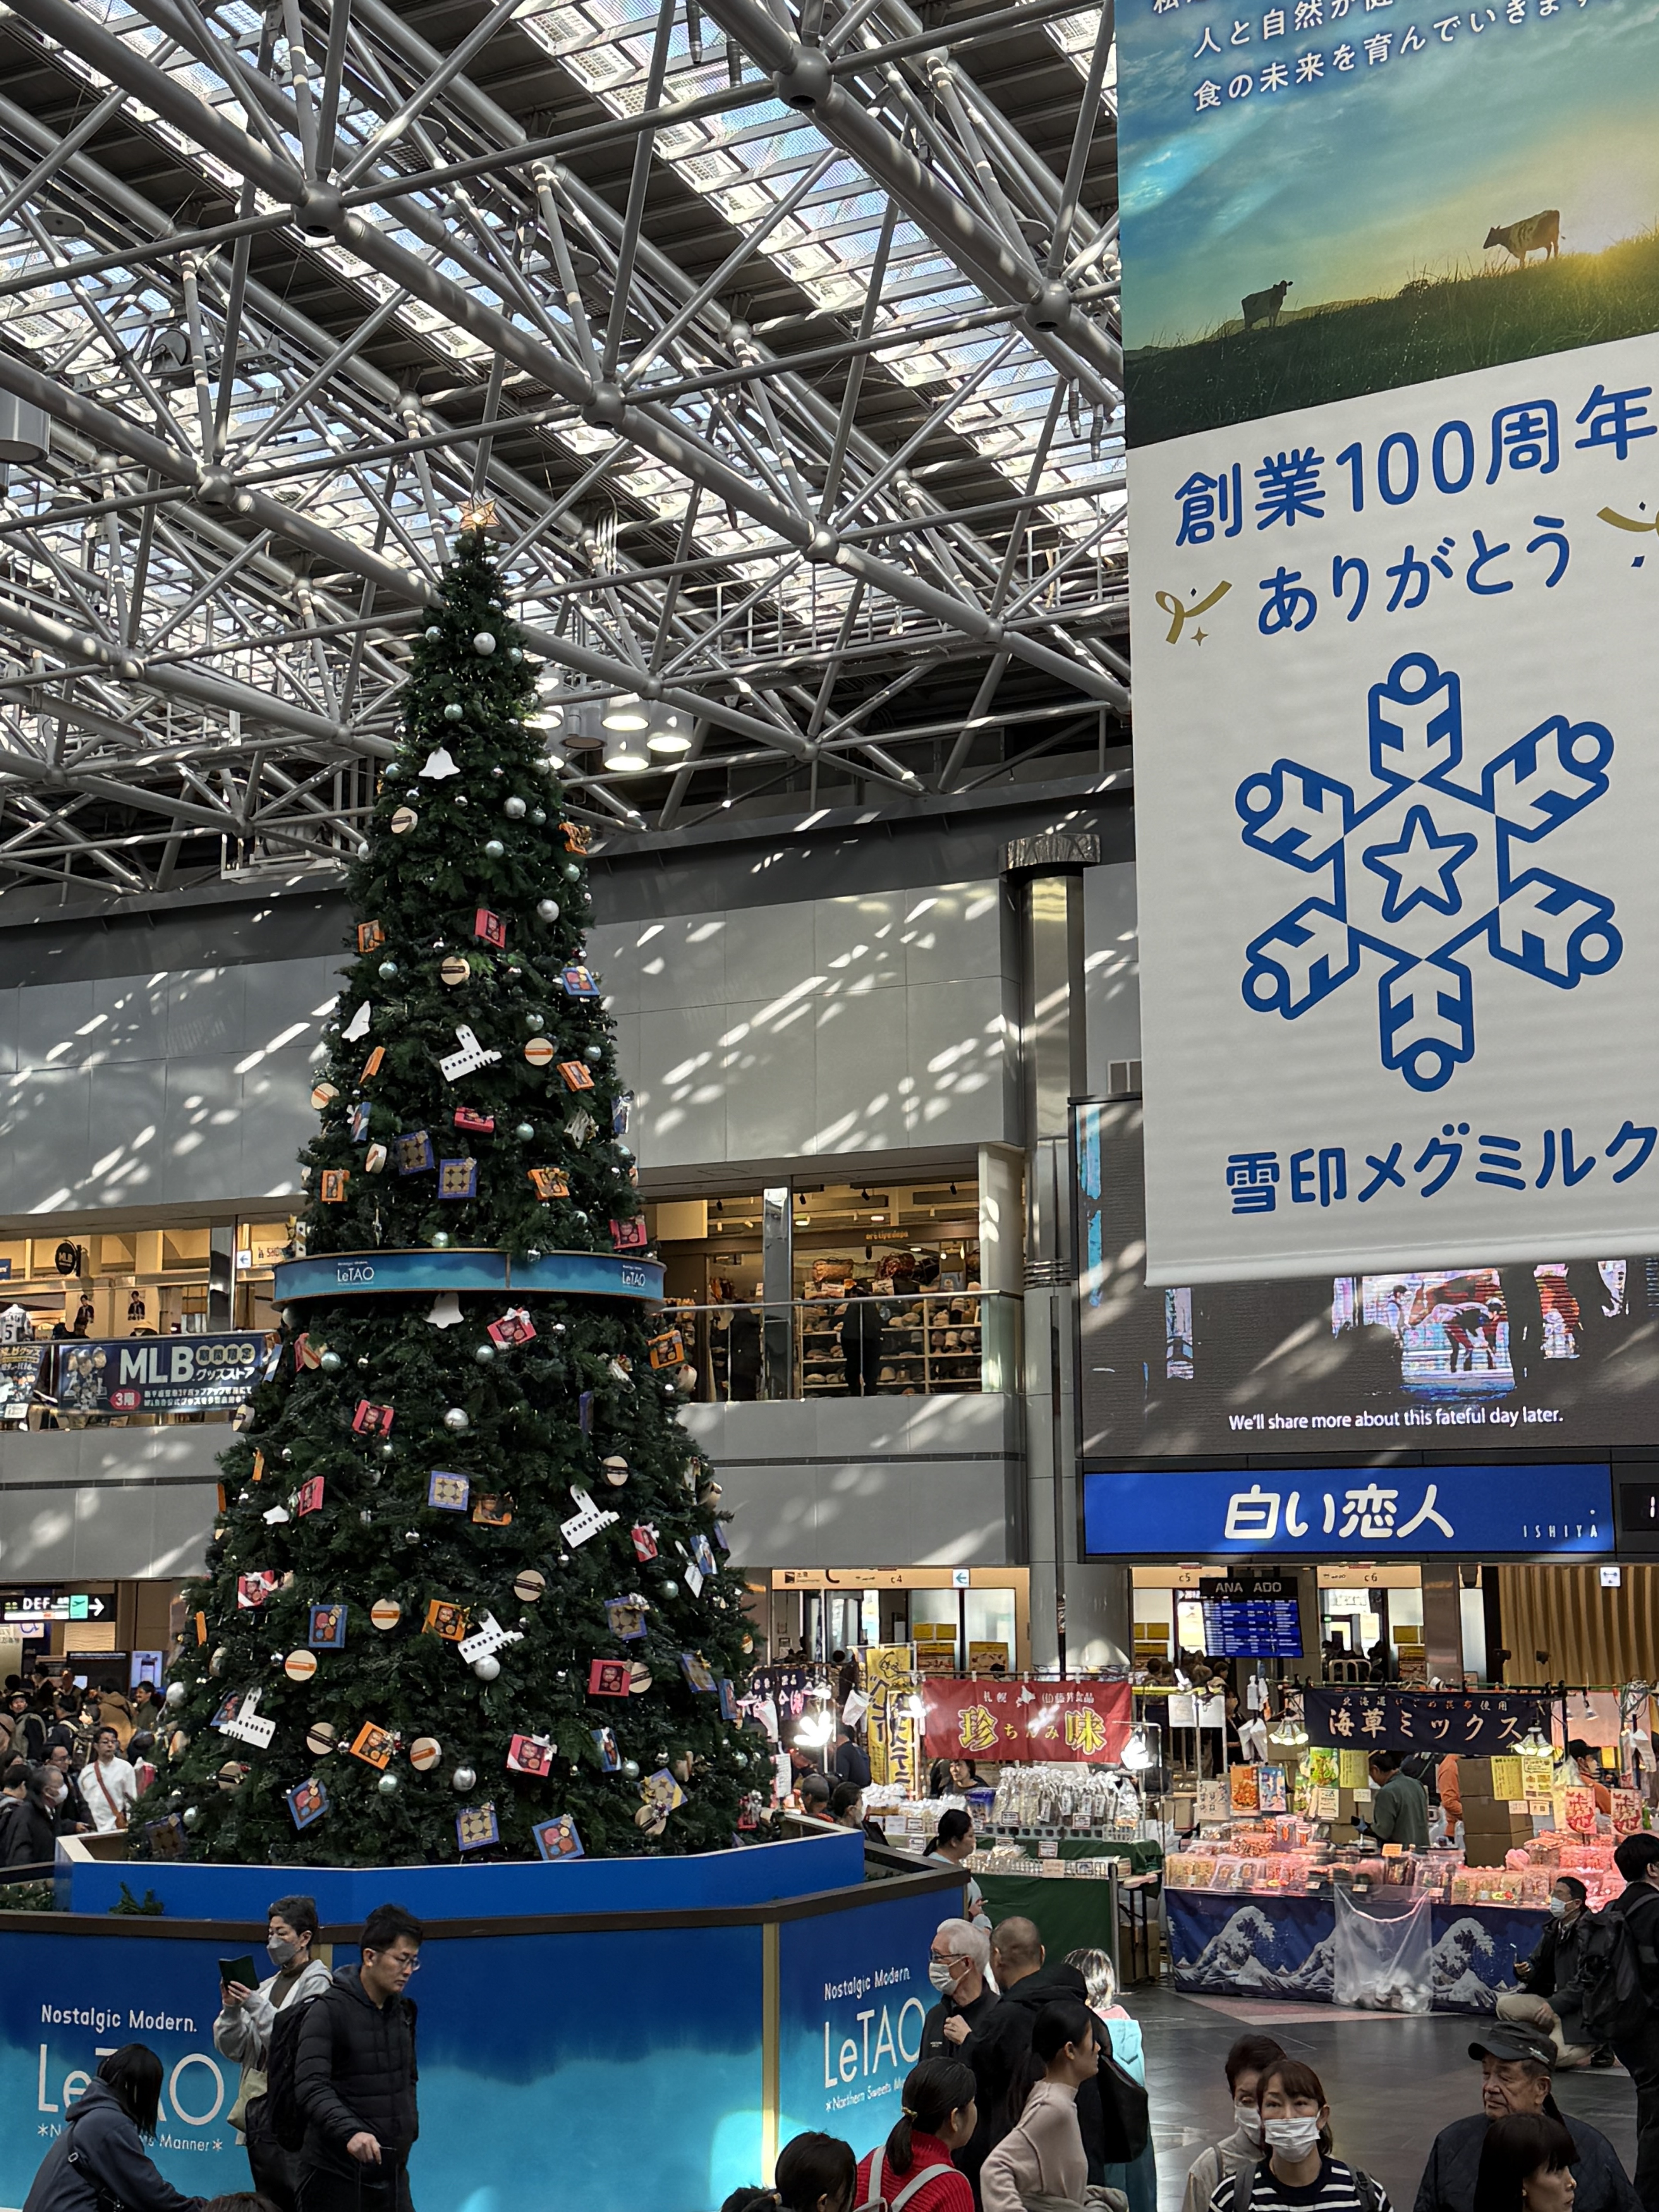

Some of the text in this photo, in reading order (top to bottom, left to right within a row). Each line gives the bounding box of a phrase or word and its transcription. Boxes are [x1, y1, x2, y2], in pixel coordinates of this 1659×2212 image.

[1174, 384, 1658, 546] 創業100周年
[1258, 515, 1570, 635] ありがとう
[1226, 1120, 1658, 1215] 雪印メグミルク
[337, 1267, 375, 1282] LeTAO
[119, 1346, 194, 1385] MLB
[1229, 1406, 1563, 1430] We'll share more about this fateful day later.
[1224, 1484, 1455, 1540] 白い恋人
[1523, 1525, 1598, 1538] ISHIYA
[23, 1597, 50, 1610] DEF
[1215, 1582, 1282, 1593] ANA ADO
[1329, 1707, 1523, 1741] 海草ミックス
[824, 1966, 910, 2001] Nostalgic Modern
[42, 2005, 197, 2033] Nostalgic Modern.
[824, 1997, 925, 2088] LeTAO
